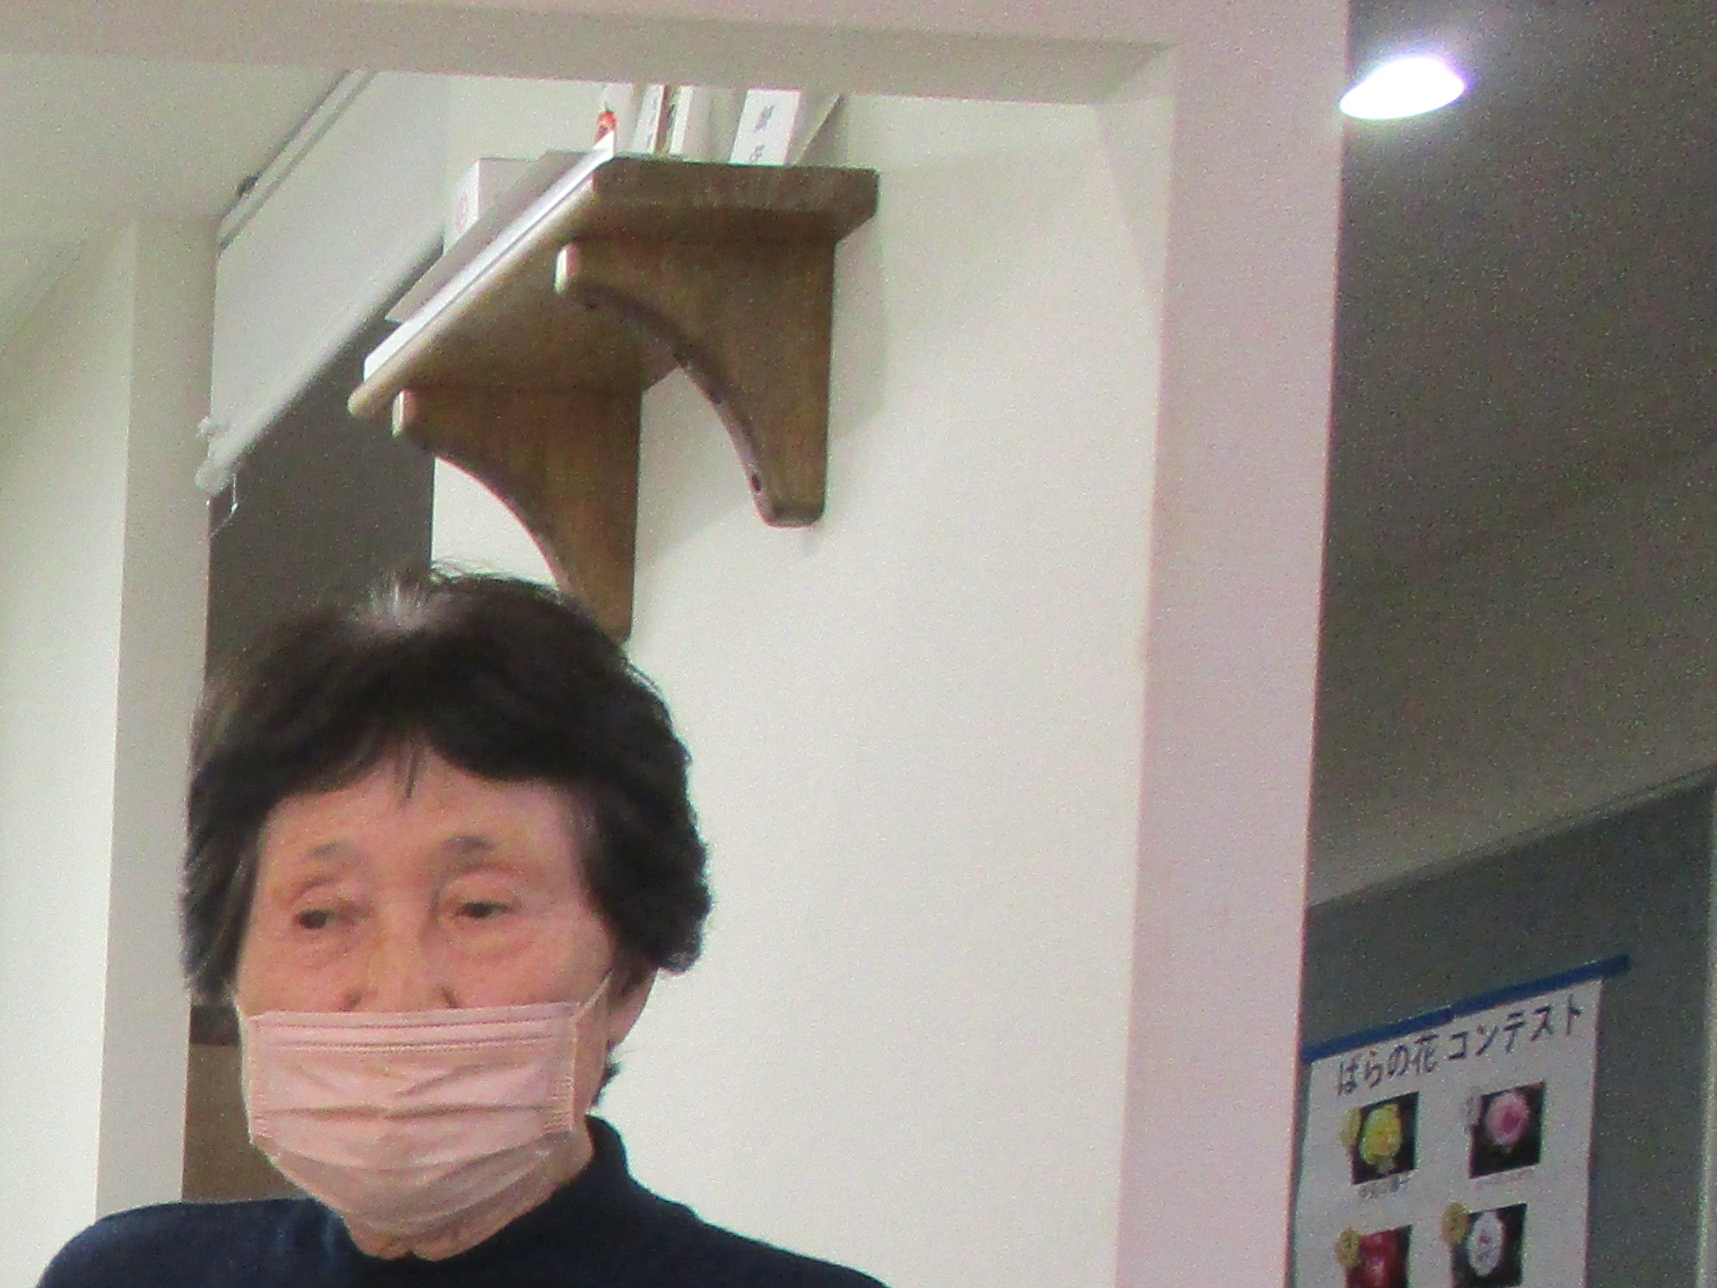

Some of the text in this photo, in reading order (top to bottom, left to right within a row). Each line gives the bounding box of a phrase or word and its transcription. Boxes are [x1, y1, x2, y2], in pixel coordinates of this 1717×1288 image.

[1336, 993, 1582, 1098] ばらの花コンテスト
